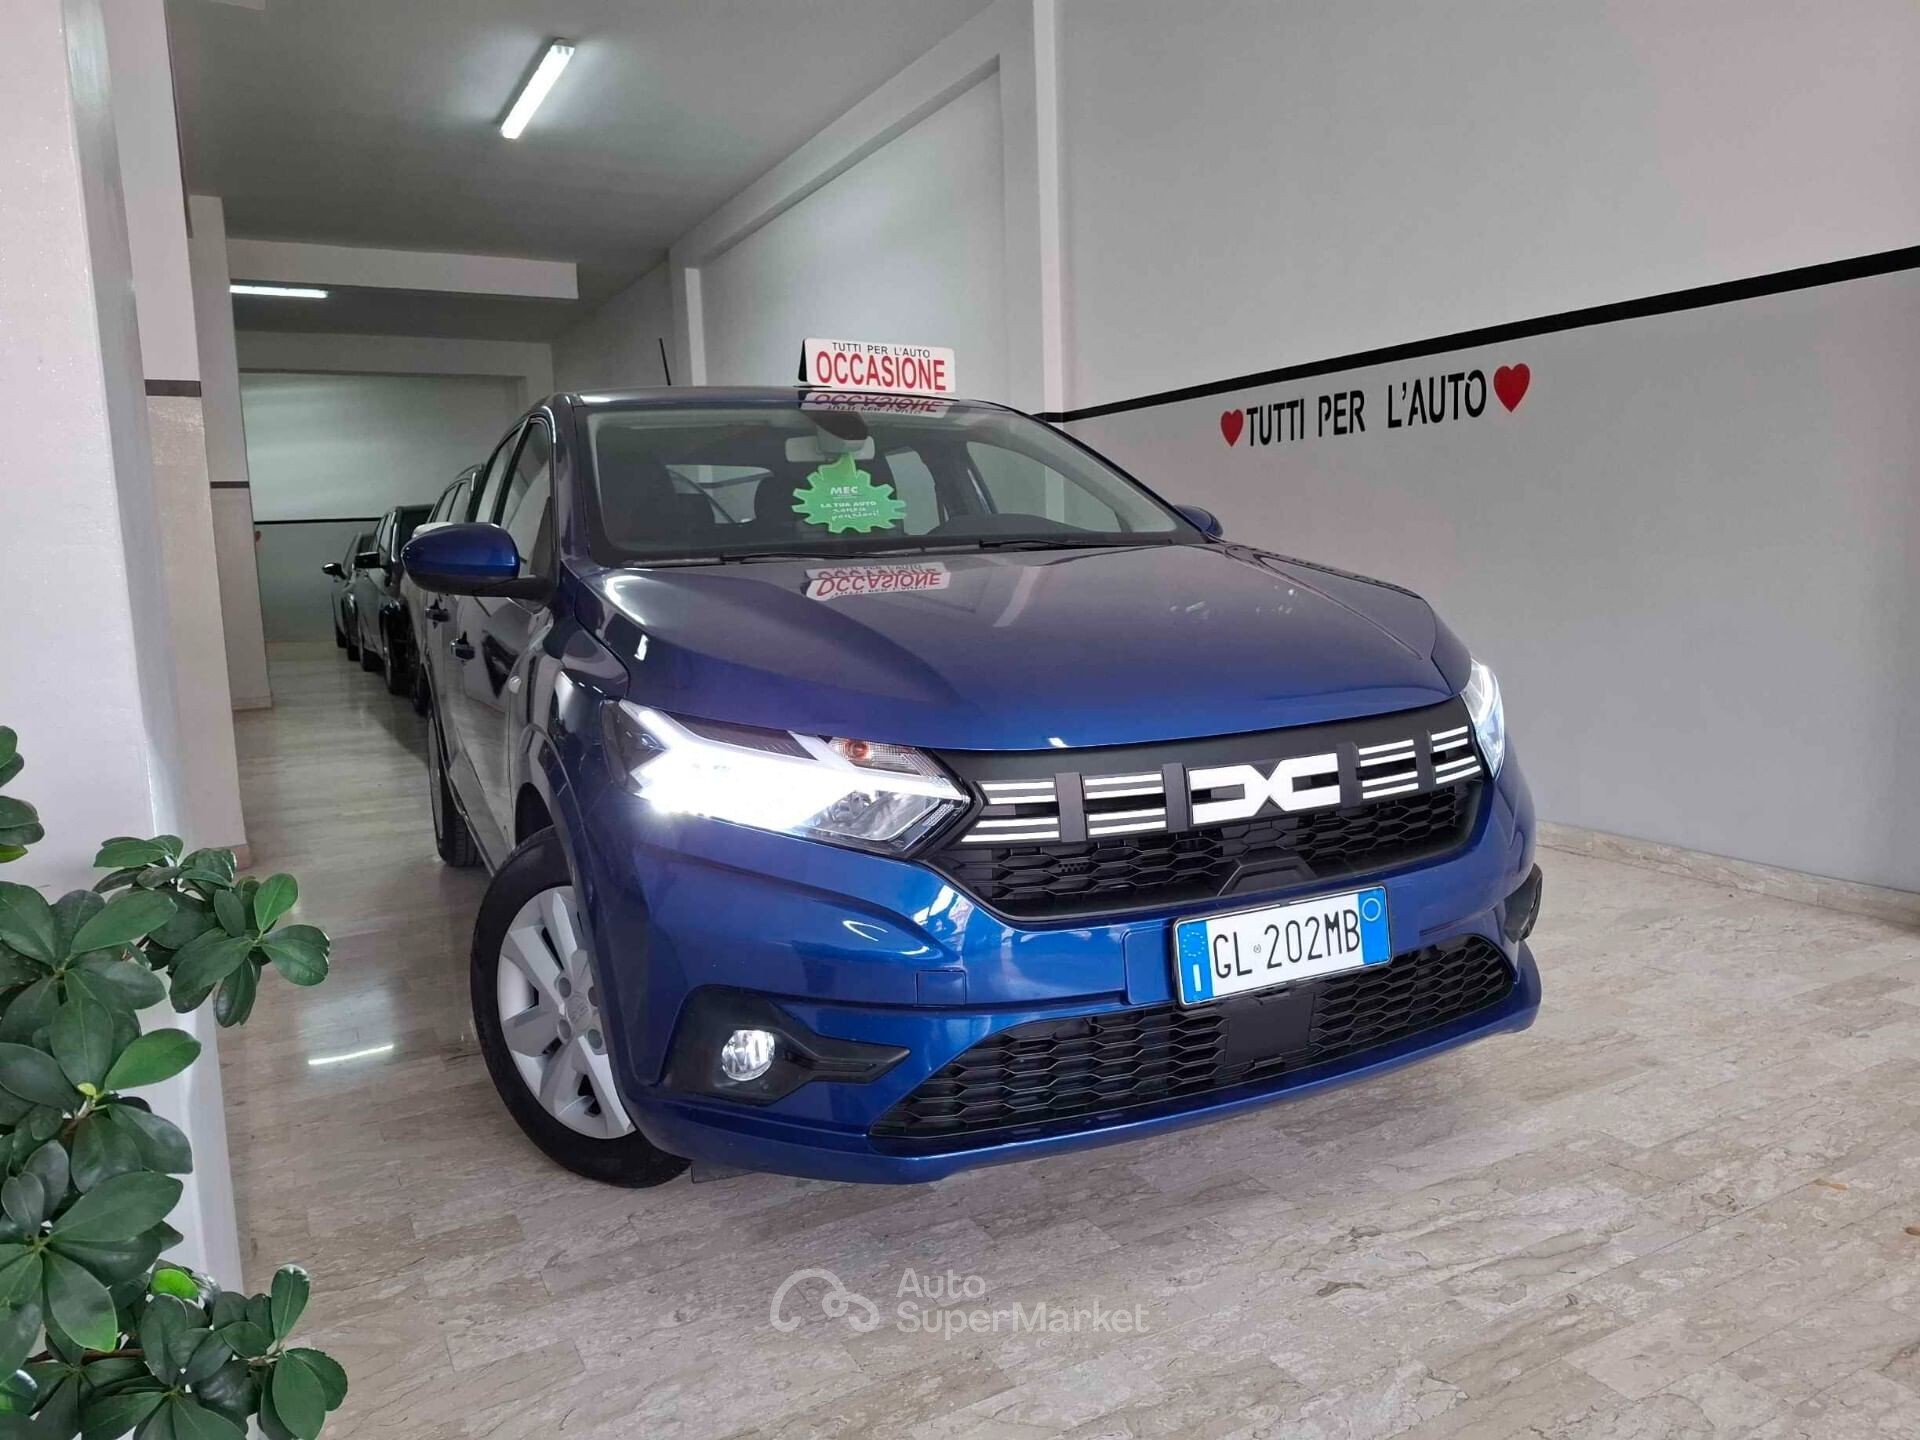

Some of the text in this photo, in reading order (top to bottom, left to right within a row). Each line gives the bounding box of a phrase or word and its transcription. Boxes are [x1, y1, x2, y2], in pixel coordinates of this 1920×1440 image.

[832, 342, 930, 358] TUTTI PER L'AUTO
[816, 351, 946, 391] OCCASIONE
[1246, 369, 1487, 447] TUTTI PER L'AUTO
[830, 486, 858, 495] MEC
